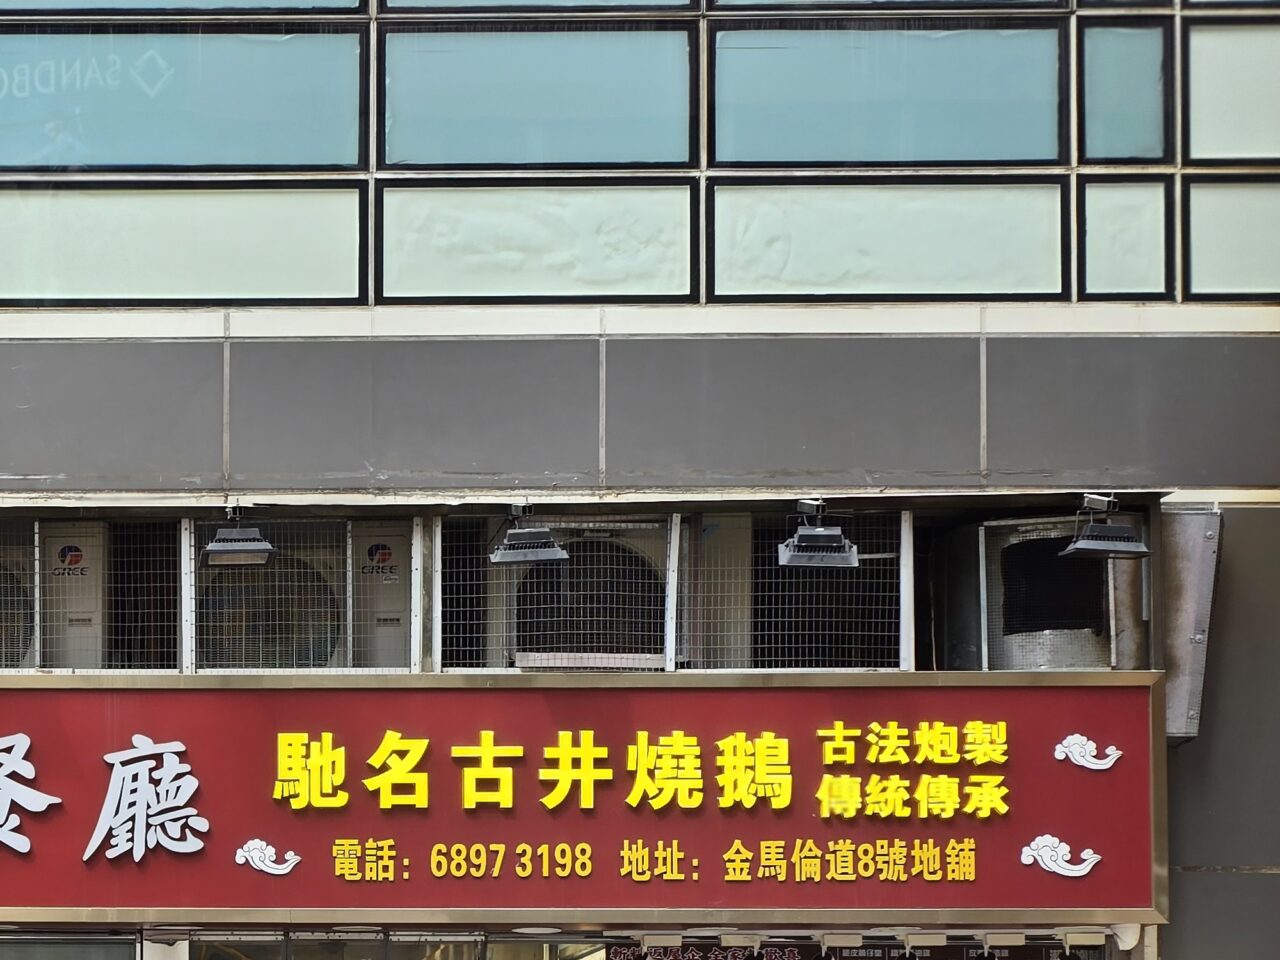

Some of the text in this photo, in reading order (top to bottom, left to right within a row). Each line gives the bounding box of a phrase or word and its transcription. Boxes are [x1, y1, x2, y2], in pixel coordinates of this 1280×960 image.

[52, 567, 89, 576] GREE
[361, 565, 399, 574] GREE
[816, 720, 1010, 765] 古法炮製
[272, 729, 793, 810] 馳名古井燒鵝
[815, 774, 1010, 818] 傳統傳承
[430, 842, 506, 878] 6897
[515, 842, 593, 878] 3198
